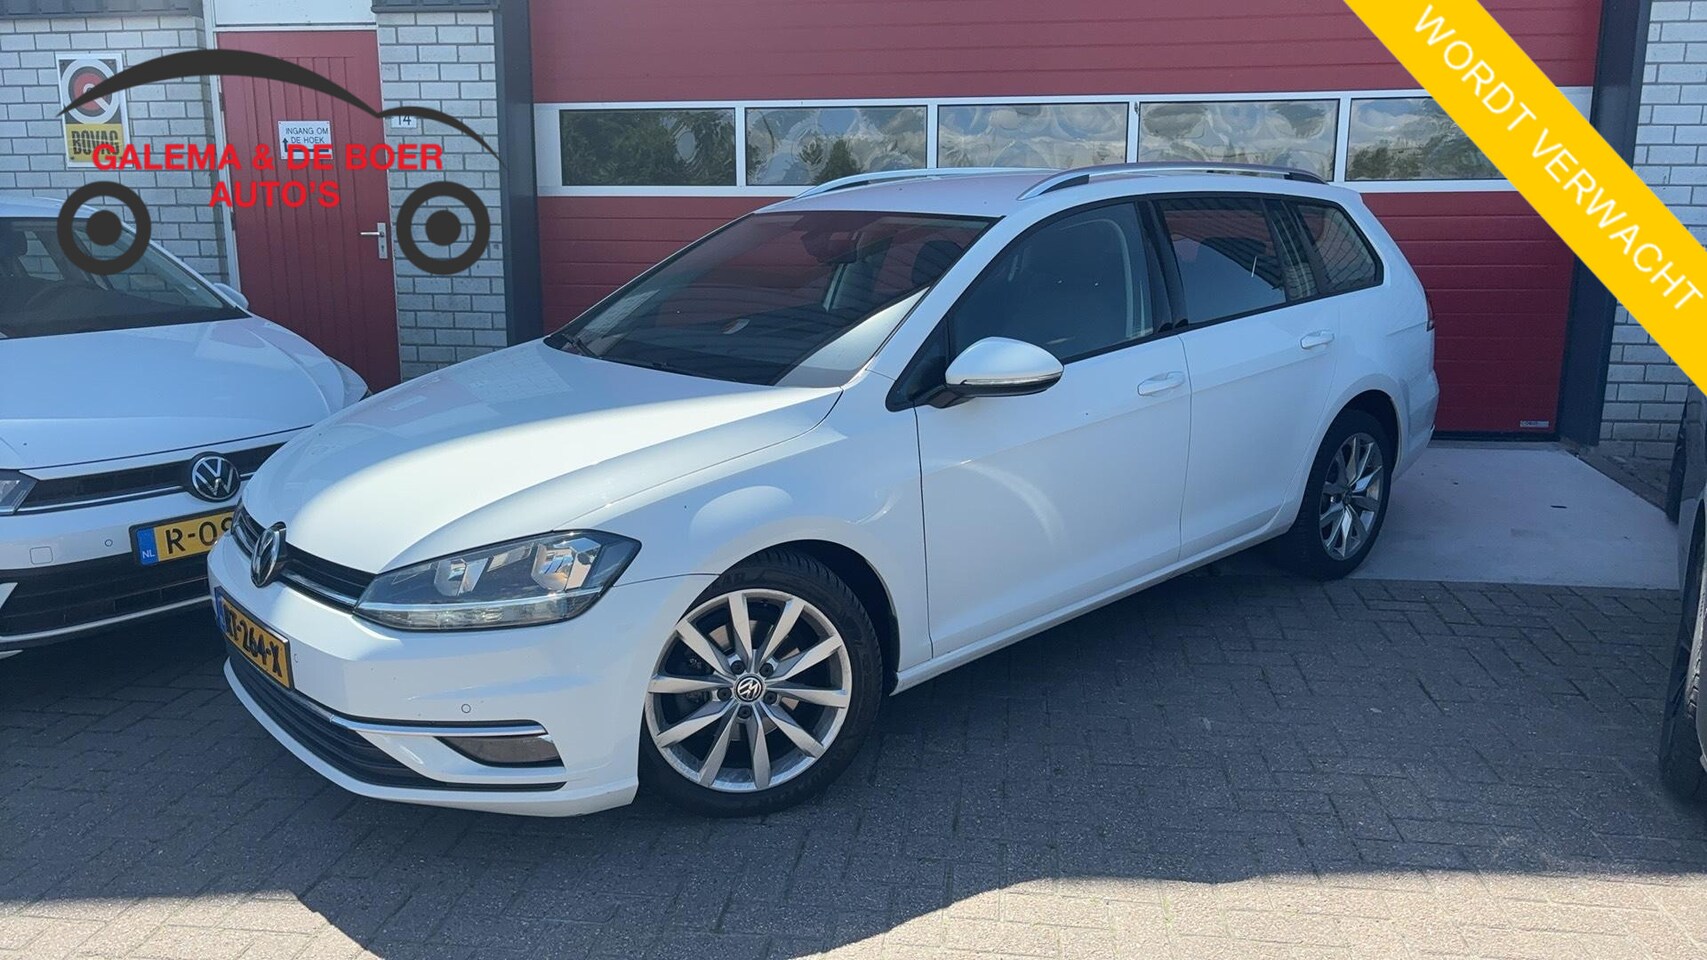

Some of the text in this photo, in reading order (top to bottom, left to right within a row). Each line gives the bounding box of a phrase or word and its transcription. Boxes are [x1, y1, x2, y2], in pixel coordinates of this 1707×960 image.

[285, 127, 329, 135] INGANG OM
[71, 130, 120, 155] BOVAG
[291, 136, 325, 144] DE HOEK
[142, 550, 155, 559] NL
